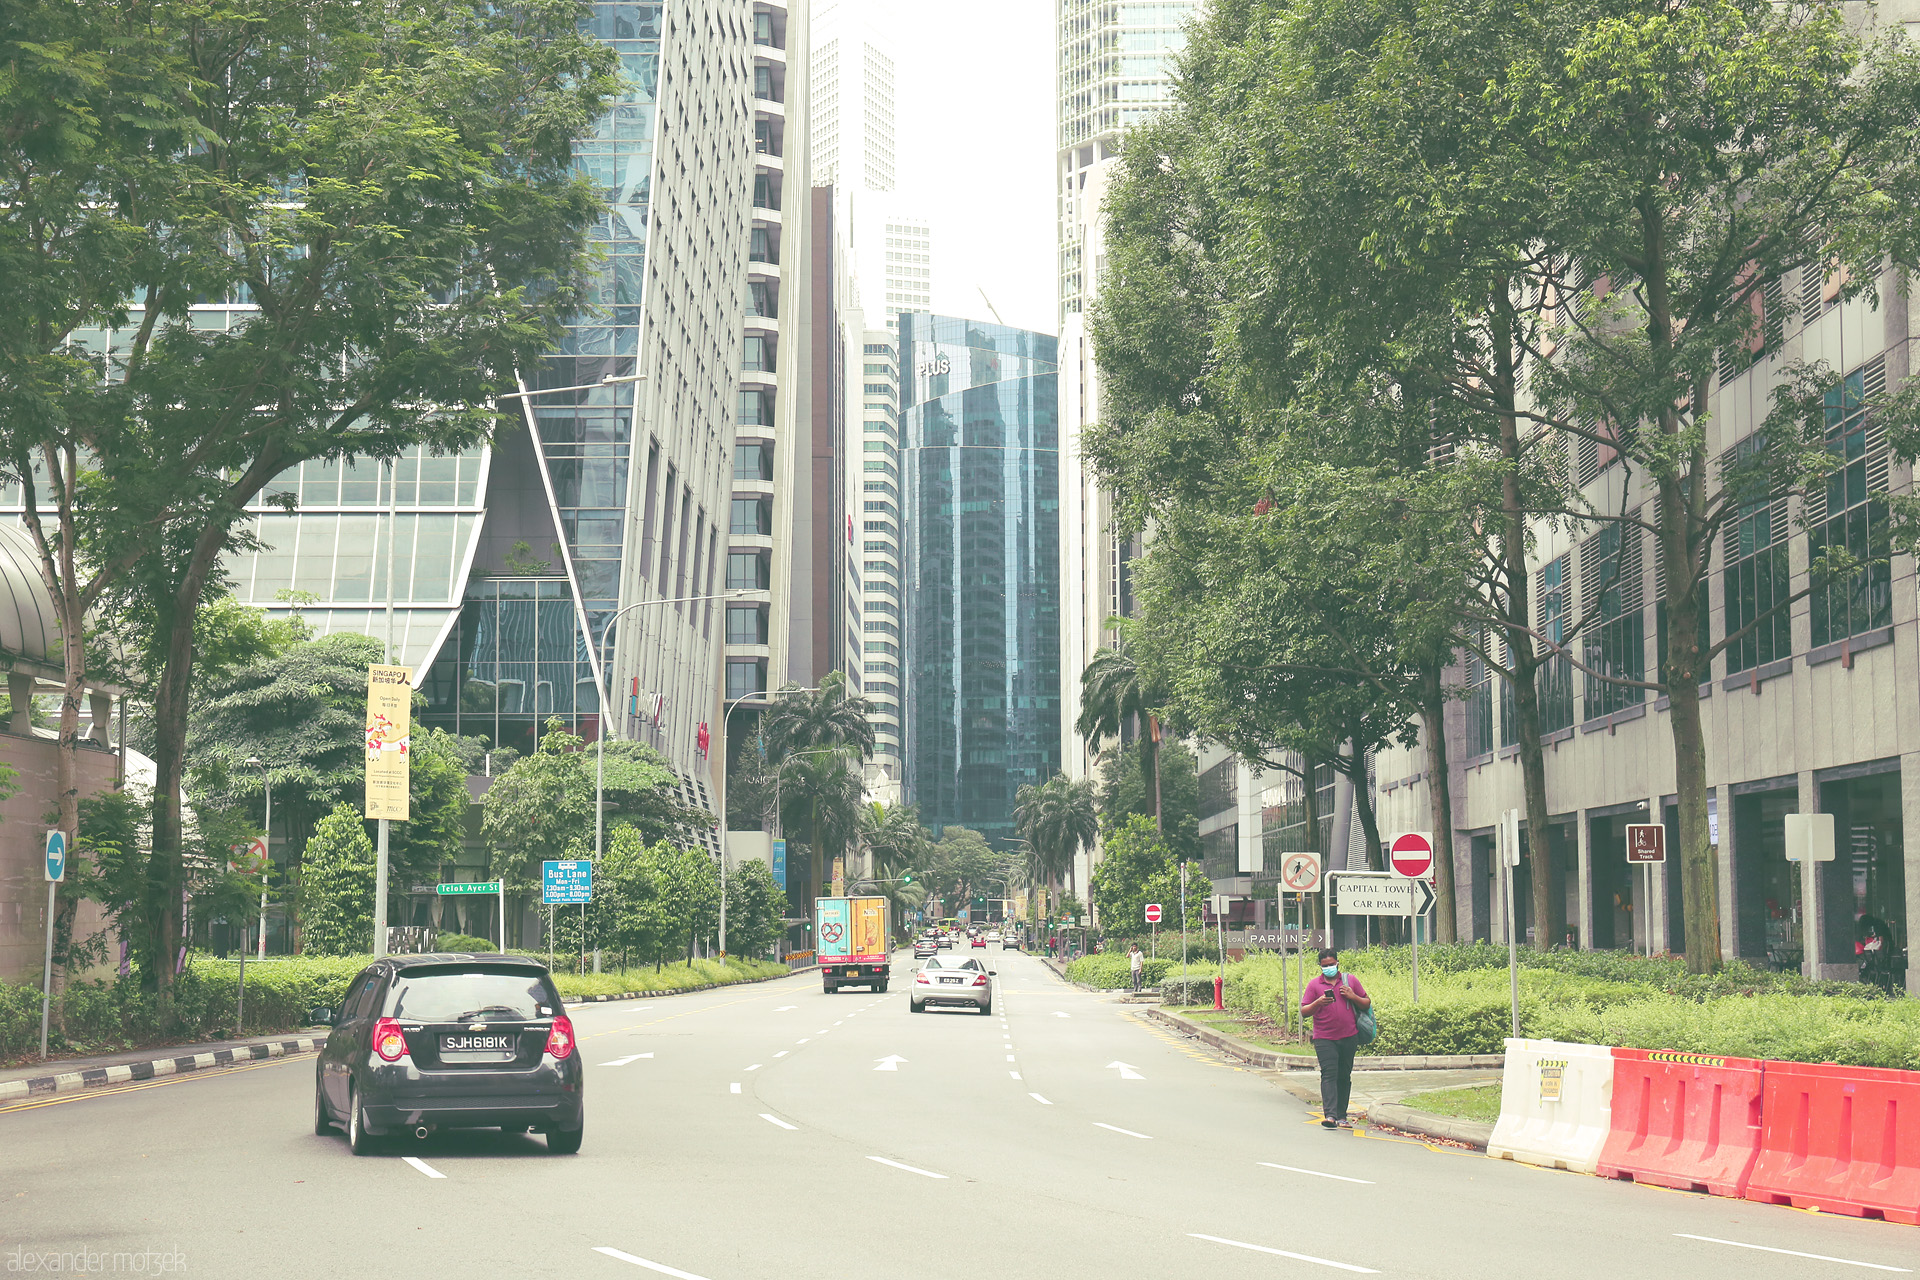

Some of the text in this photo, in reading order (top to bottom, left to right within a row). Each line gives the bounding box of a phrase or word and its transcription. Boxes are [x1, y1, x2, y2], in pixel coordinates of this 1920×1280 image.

[372, 669, 402, 678] SINGAPO
[548, 869, 587, 878] Bus Lane
[442, 884, 464, 892] Telok
[467, 884, 486, 893] Ayer
[489, 883, 498, 891] St
[1339, 884, 1419, 894] CAPITAL TOWER
[1353, 899, 1401, 909] CAR PARK
[1250, 934, 1308, 944] PARKING
[446, 1036, 508, 1049] SJH6181K
